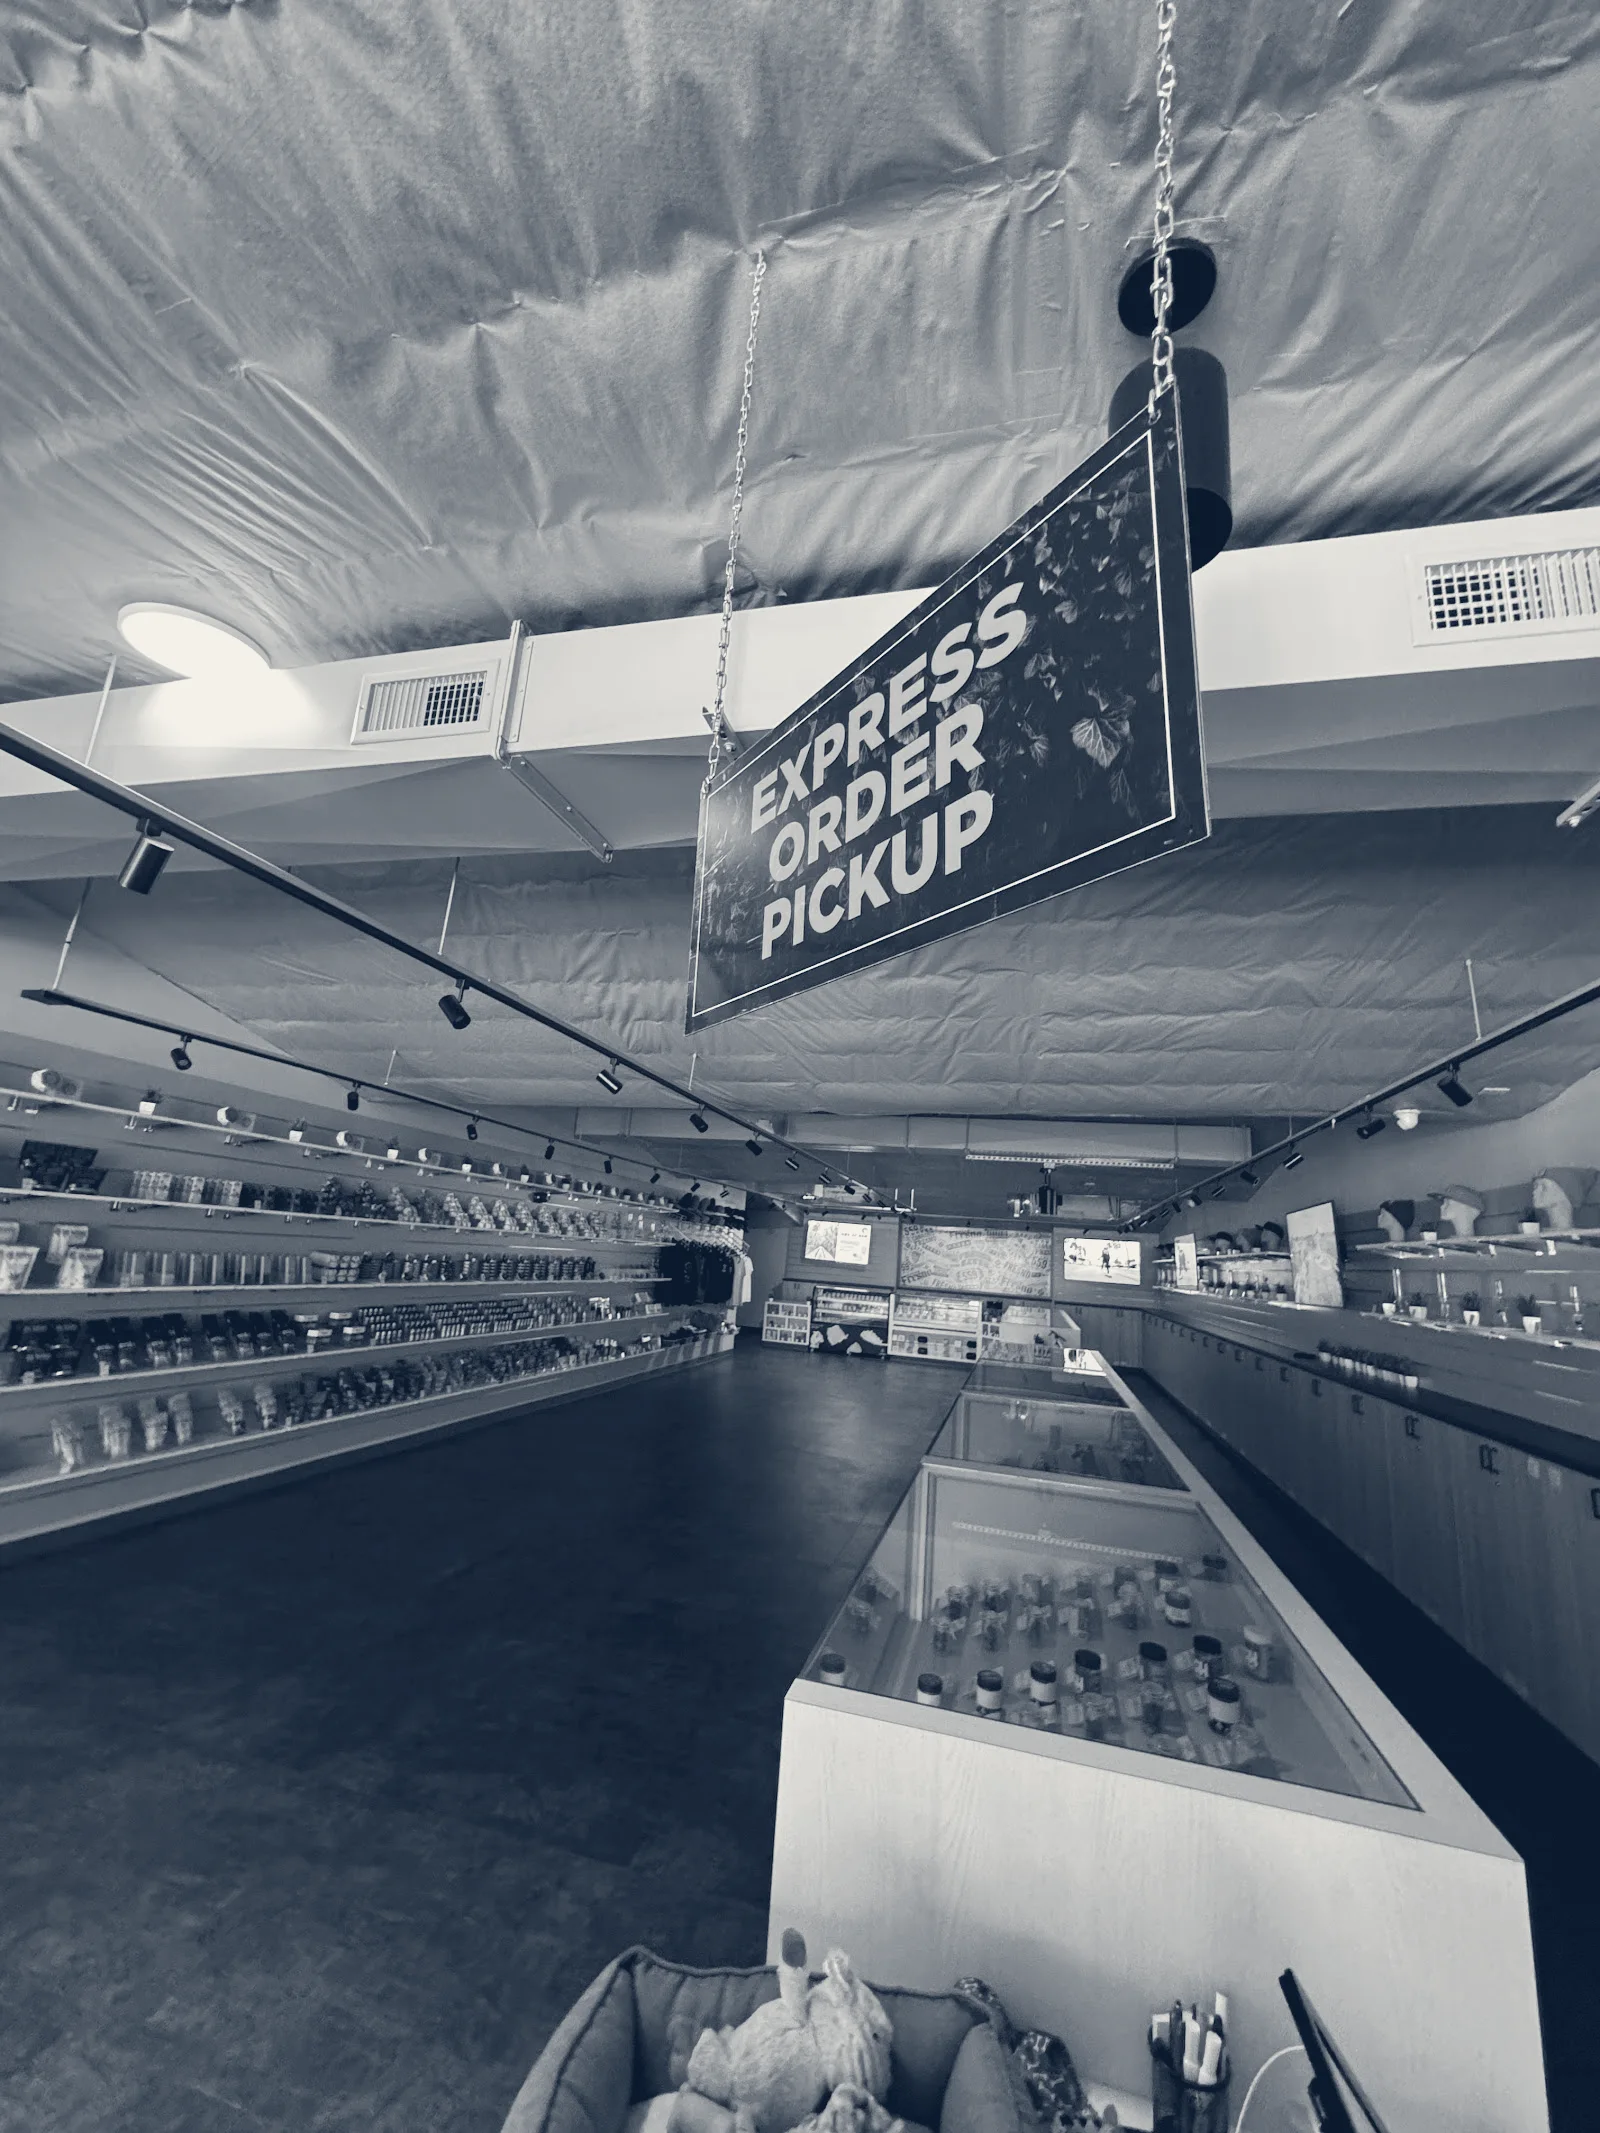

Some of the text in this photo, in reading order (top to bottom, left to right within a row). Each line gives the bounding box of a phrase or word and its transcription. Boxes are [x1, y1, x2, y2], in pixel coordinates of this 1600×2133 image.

[751, 582, 1027, 833] EXPRESS
[769, 703, 985, 882] ORDER
[761, 790, 994, 960] PICKUP
